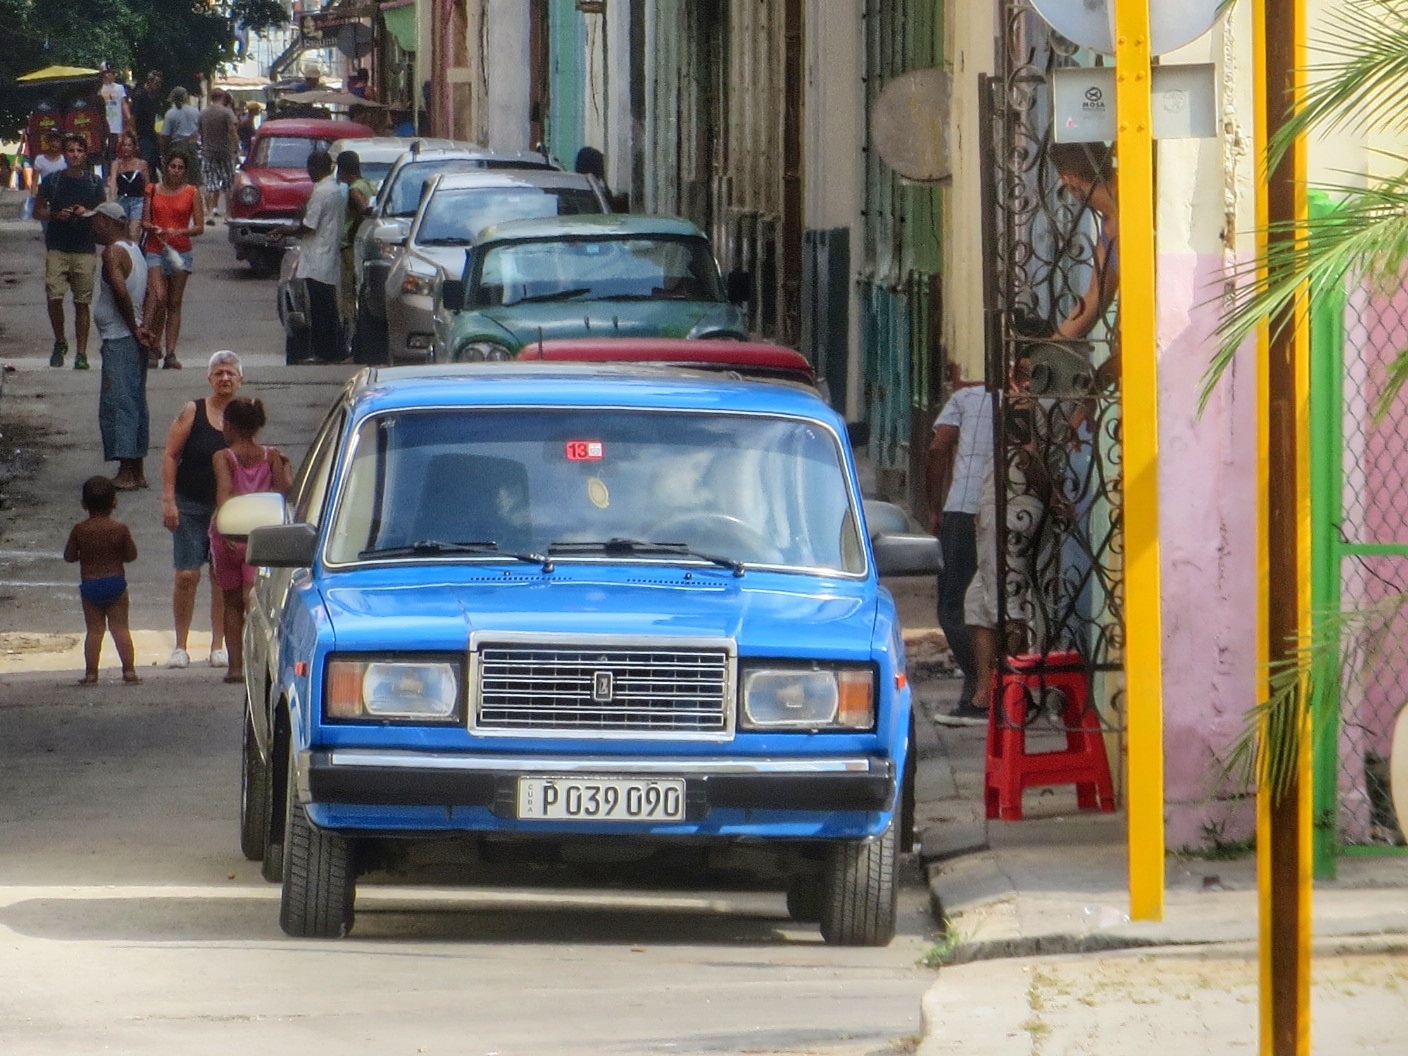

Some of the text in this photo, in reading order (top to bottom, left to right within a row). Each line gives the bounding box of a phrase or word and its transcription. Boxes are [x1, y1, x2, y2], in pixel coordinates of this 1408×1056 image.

[568, 443, 587, 458] 13
[542, 785, 680, 817] P 039 090
